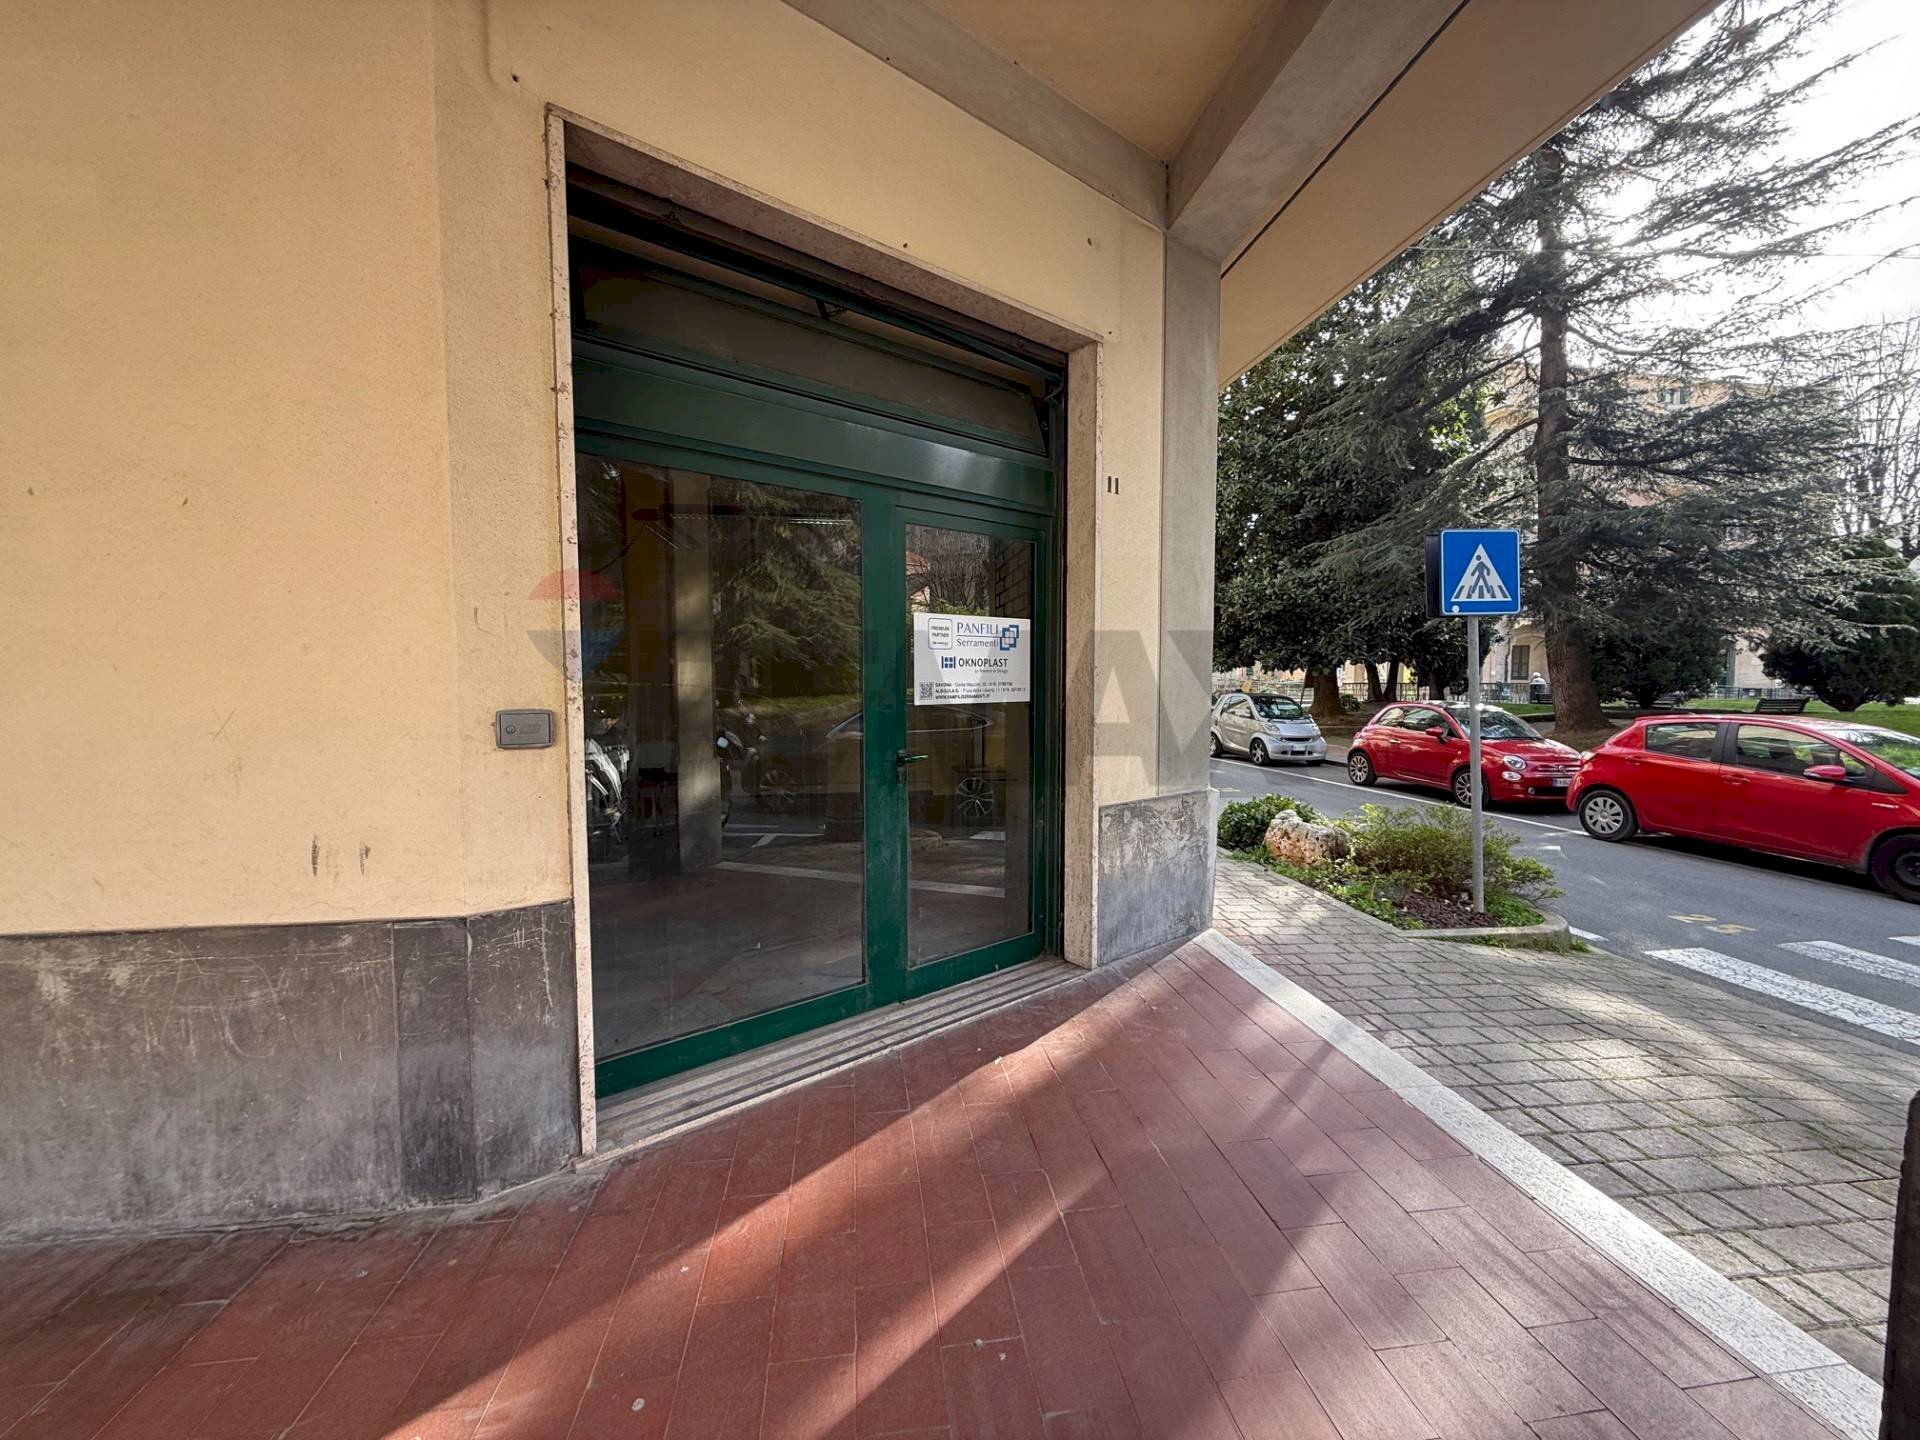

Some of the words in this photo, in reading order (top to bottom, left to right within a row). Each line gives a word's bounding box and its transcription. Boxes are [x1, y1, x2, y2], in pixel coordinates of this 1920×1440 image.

[956, 622, 998, 635] PANFILI
[956, 638, 998, 648] Serramenti
[958, 657, 1008, 668] OKNOPLAST
